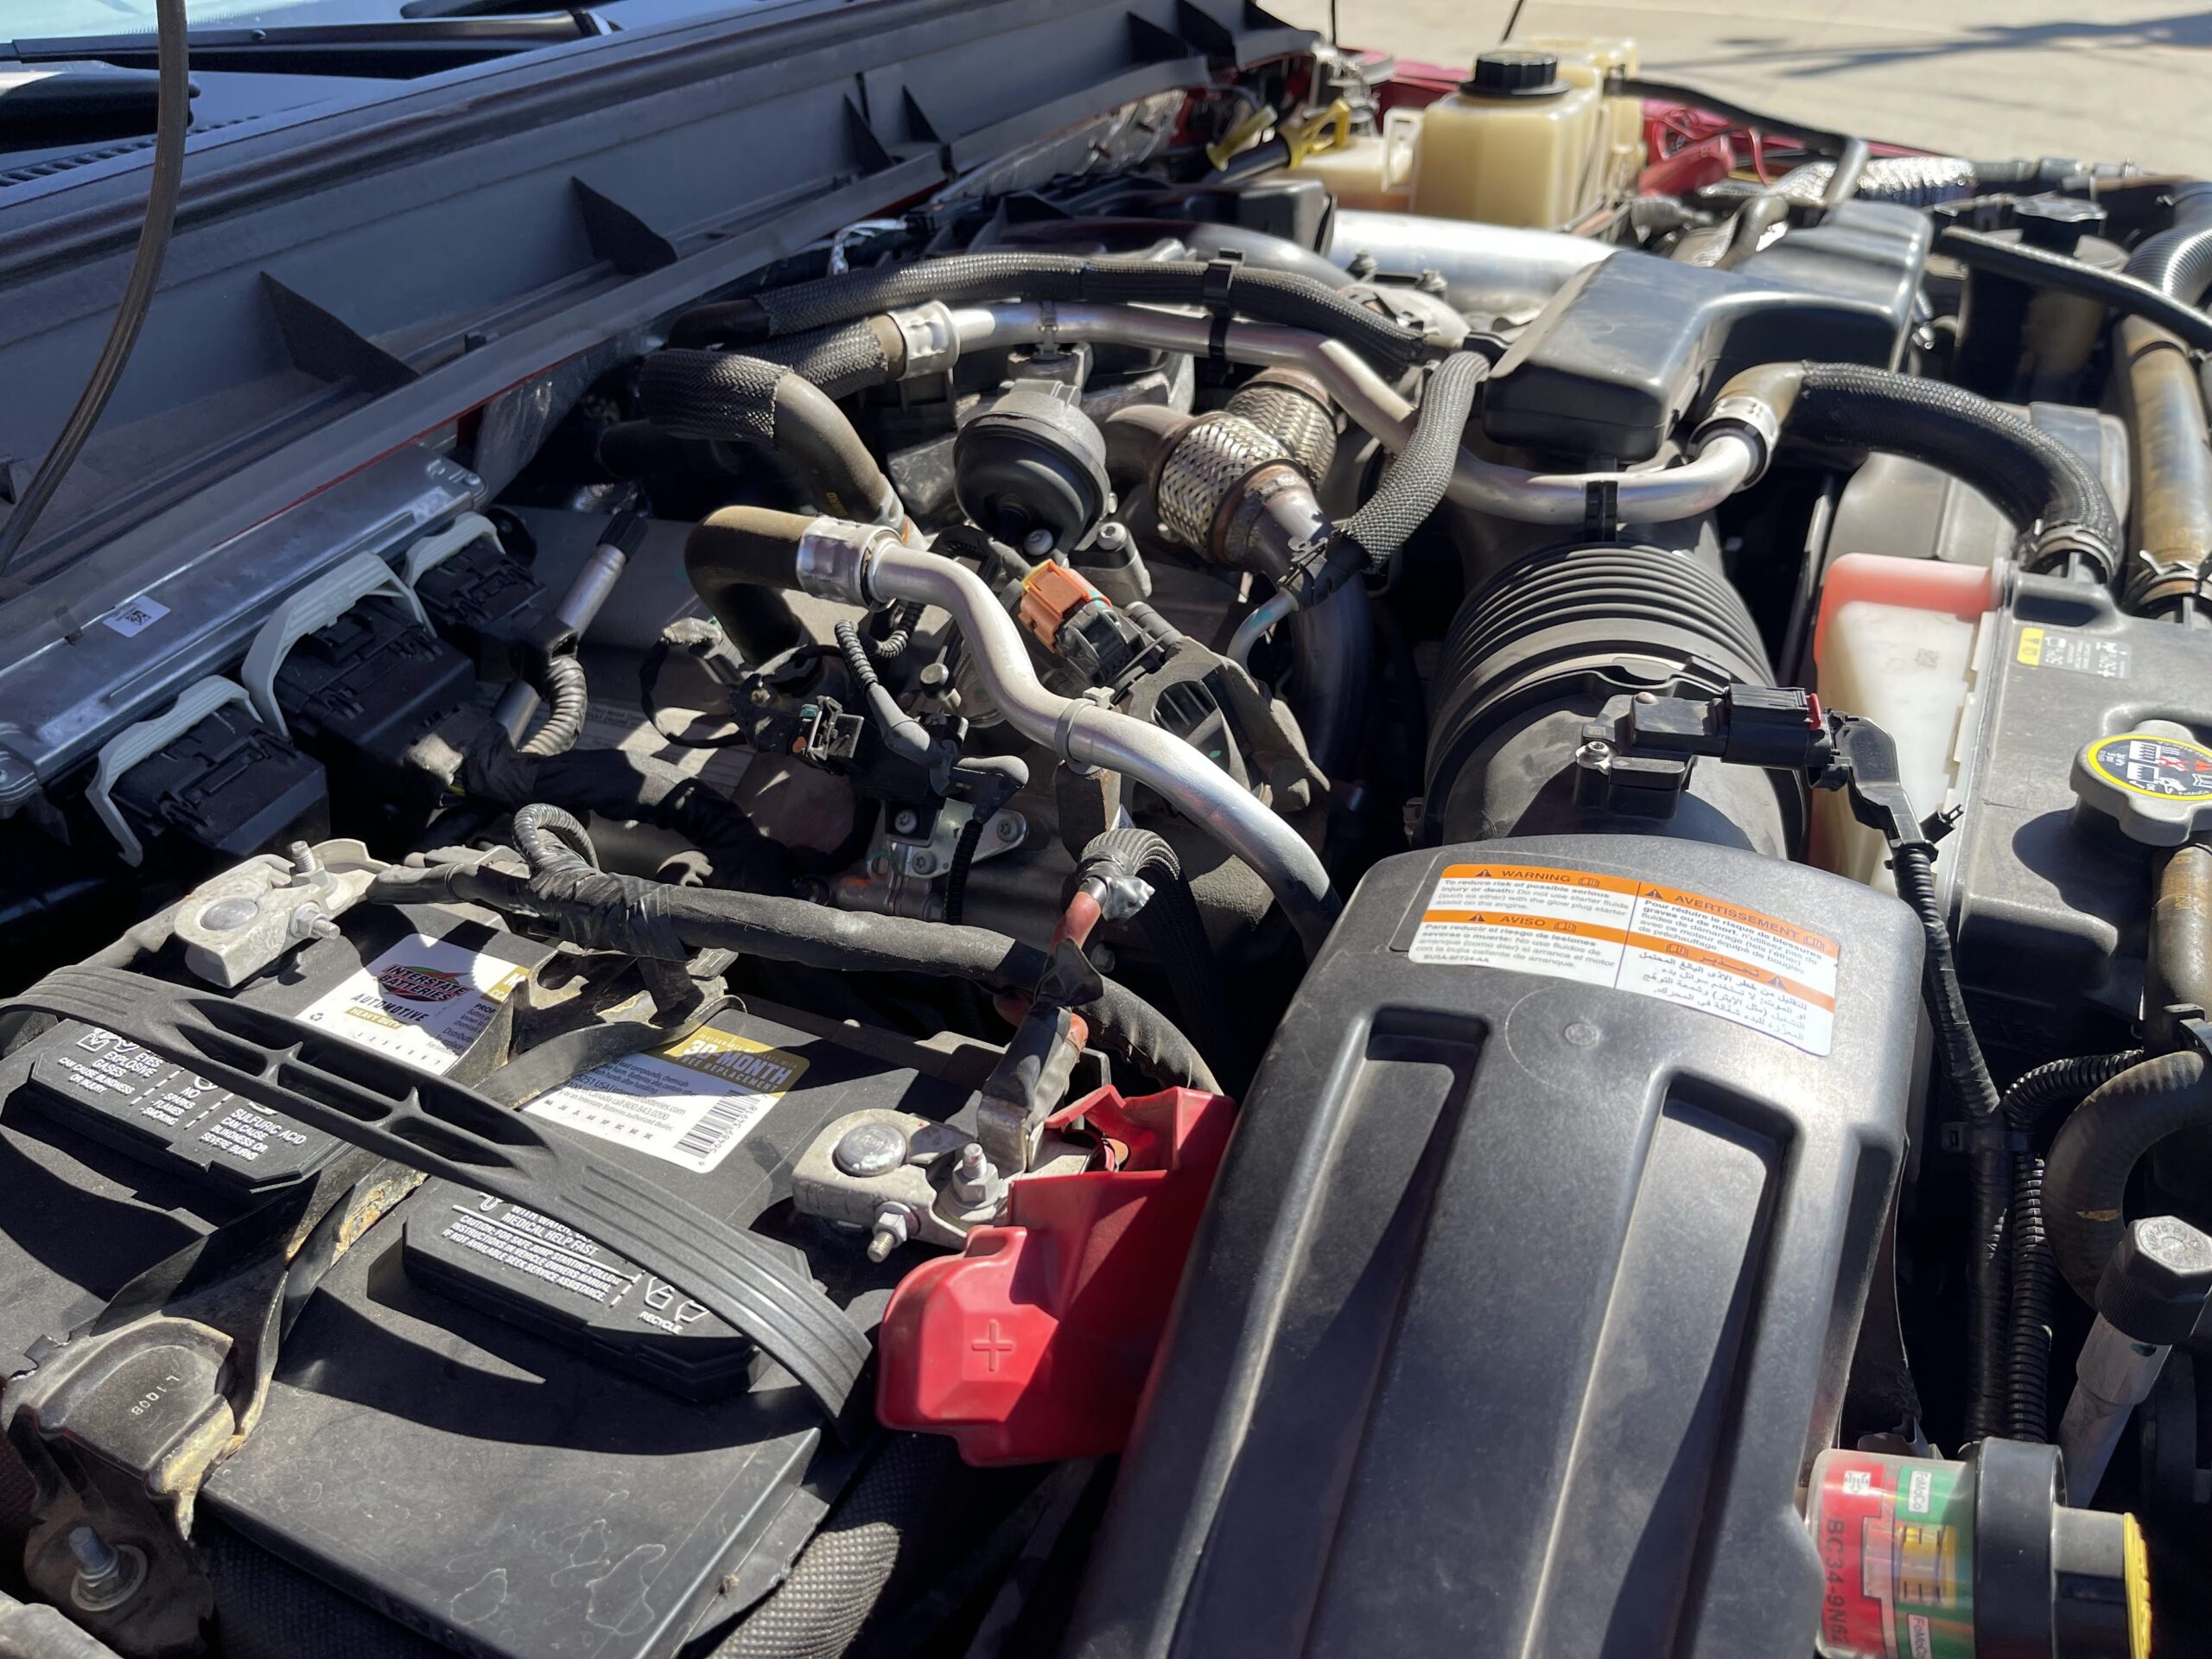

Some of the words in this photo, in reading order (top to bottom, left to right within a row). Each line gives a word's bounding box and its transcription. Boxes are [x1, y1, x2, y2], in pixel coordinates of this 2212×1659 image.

[1502, 870, 1570, 882] WARNING
[1526, 883, 1569, 893] possible
[1571, 888, 1610, 899] serious
[1571, 895, 1601, 904] starter
[1604, 900, 1629, 909] fluids
[1500, 916, 1545, 926] AVISO
[1571, 902, 1592, 911] plug
[1595, 907, 1626, 916] starter
[1674, 895, 1800, 938] AVERTISSEMENT
[1500, 928, 1533, 937] riesgo
[1552, 933, 1596, 947] lesiones
[1642, 912, 1673, 925] fluides
[1690, 925, 1743, 944] démarrage
[1745, 941, 1766, 954] (tels
[1643, 907, 1677, 918] graves
[1742, 933, 1782, 950] n'utilisez
[1785, 950, 1802, 959] pas
[1805, 956, 1817, 964] de
[1645, 899, 1669, 909] Pour
[1671, 906, 1707, 919] réduire
[1723, 919, 1755, 933] risque
[1773, 937, 1821, 960] blessures
[1472, 949, 1511, 957] caliente
[1529, 956, 1576, 968] arranque.
[1533, 949, 1571, 959] arranca
[1585, 957, 1616, 967] motor
[1554, 943, 1585, 952] fluidos
[1640, 919, 1663, 928] avec
[1680, 929, 1714, 943] moteur
[1717, 938, 1750, 953] équipé
[1752, 950, 1764, 959] de
[1768, 956, 1804, 975] bougies
[378, 975, 452, 1001] BATTERIES
[388, 966, 467, 995] INTERSTATE
[350, 994, 429, 1022] AUTOMOTIVE
[350, 1007, 381, 1022] HEAVY
[378, 1016, 403, 1028] DUTY
[92, 1058, 126, 1078] GASES
[104, 1051, 157, 1078] EXPLOSIVE
[135, 1052, 163, 1068] EYES
[683, 1040, 793, 1085] 30-MONTH
[58, 1057, 76, 1068] CAN
[73, 1064, 99, 1078] CAUSE
[95, 1073, 135, 1096] BLINDNESS
[69, 1073, 83, 1084] OR
[81, 1078, 107, 1093] INJURY
[704, 1063, 778, 1092] REPLACEMENT
[162, 1093, 196, 1111] SPARKS
[181, 1086, 201, 1099] NO
[142, 1106, 179, 1126] SMOKING
[154, 1099, 185, 1116] FLAMES
[211, 1125, 256, 1147] BLINDNESS
[251, 1142, 269, 1154] OR
[221, 1116, 242, 1128] CAN
[238, 1125, 269, 1141] CAUSE
[231, 1108, 282, 1135] SULFURIC
[277, 1130, 307, 1145] ACID
[200, 1132, 232, 1149] SEVERE
[228, 1145, 259, 1161] BURNS
[501, 1212, 545, 1237] MEDICAL
[544, 1230, 574, 1248] HELP
[570, 1241, 599, 1256] FAST
[451, 1222, 508, 1248] INSTRUCTIONS
[504, 1244, 515, 1253] IN
[513, 1248, 546, 1266] VEHICLE
[544, 1260, 581, 1281] OWNERS
[579, 1274, 612, 1294] MANUAL
[460, 1215, 496, 1236] CAUTION:
[494, 1230, 513, 1242] FOR
[511, 1236, 532, 1249] SAFE
[529, 1243, 554, 1258] JUMP
[551, 1252, 591, 1272] STARTING
[588, 1266, 623, 1286] FOLLOW
[442, 1229, 454, 1237] IF
[451, 1232, 470, 1244] NOT
[467, 1237, 508, 1262] AVAILABLE
[505, 1255, 528, 1269] SEEK
[524, 1263, 560, 1282] SERVICE
[556, 1279, 606, 1303] ASSISTANCE.
[638, 1310, 683, 1335] RECYCLE
[1912, 1472, 1929, 1510] FoMoCo
